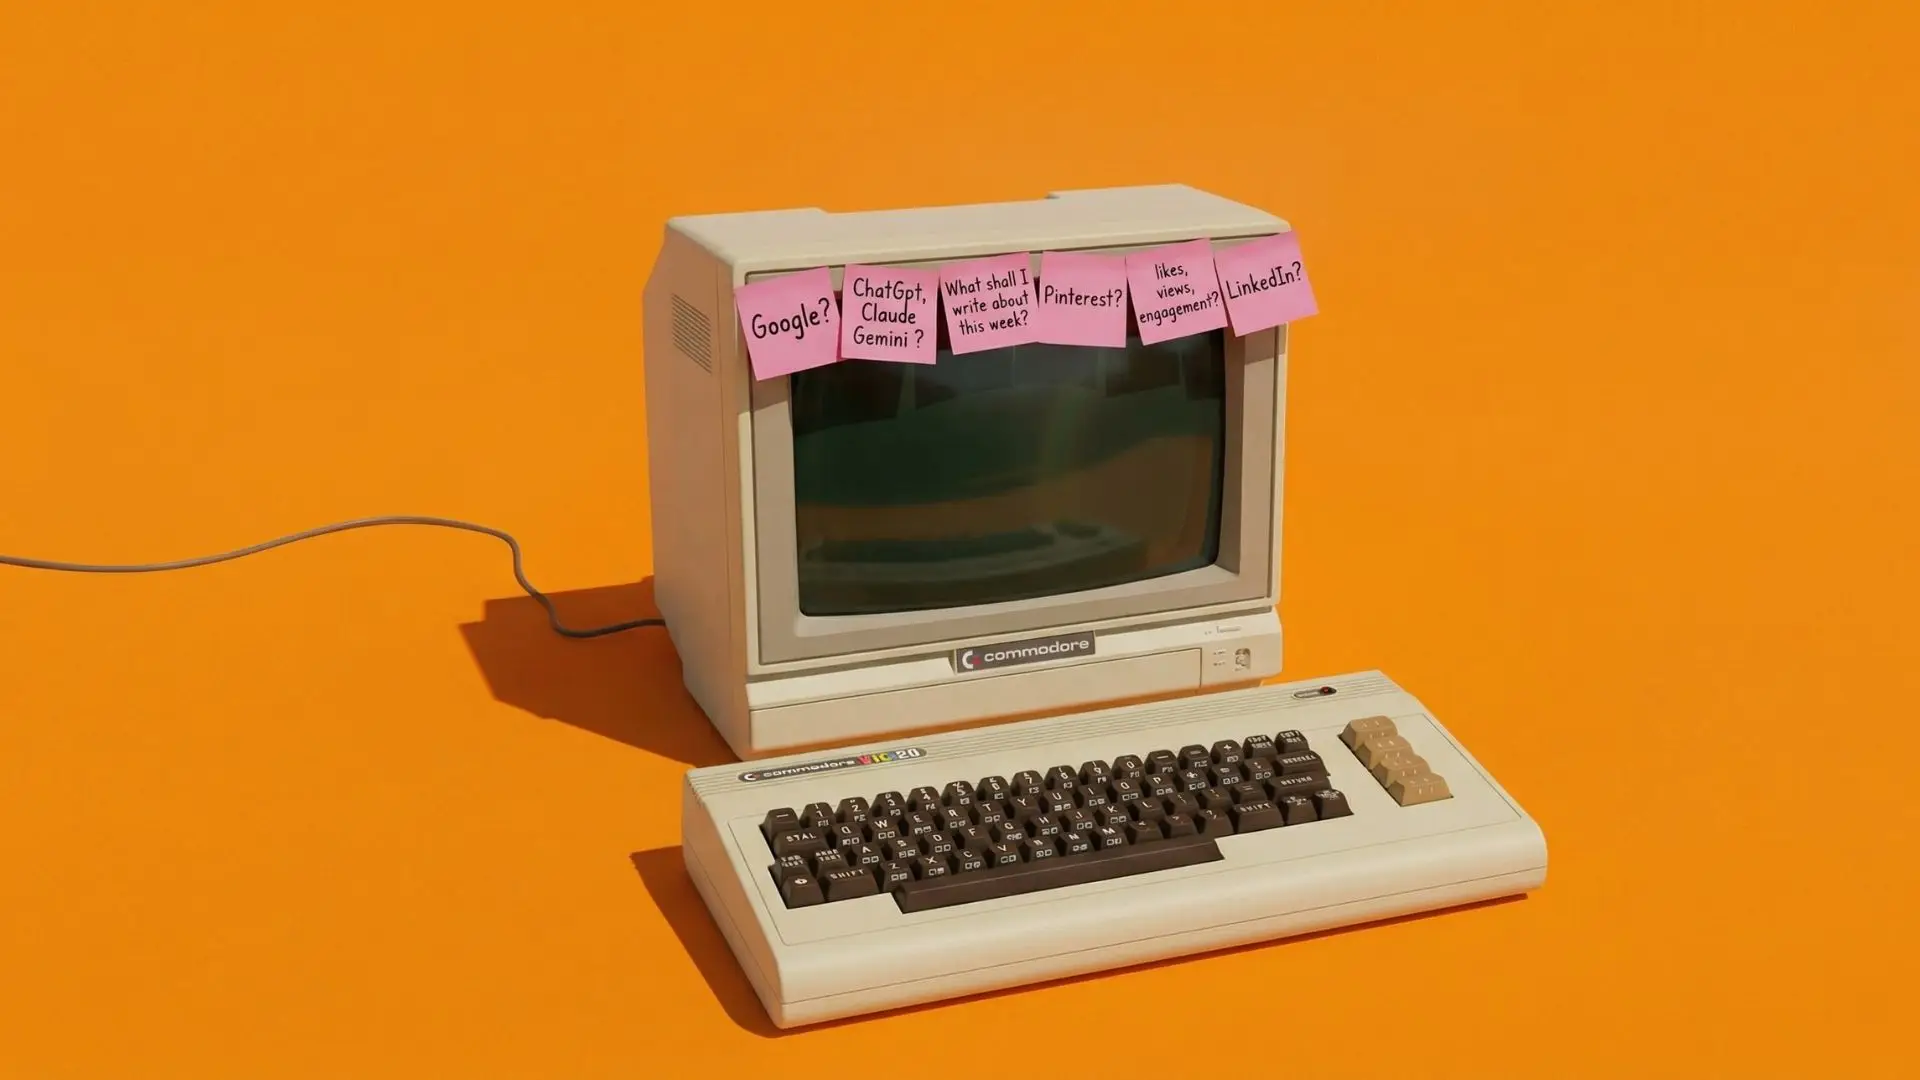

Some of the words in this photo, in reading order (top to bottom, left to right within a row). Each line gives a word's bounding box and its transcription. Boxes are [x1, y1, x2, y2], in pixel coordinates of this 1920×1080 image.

[945, 277, 981, 297] What
[987, 271, 1017, 291] shall
[1020, 268, 1030, 285] I
[1155, 262, 1188, 281] likes,
[1225, 261, 1301, 299] LinkedIn?
[853, 277, 927, 308] ChatGpt,
[1045, 285, 1123, 307] Pinterest?
[1156, 282, 1195, 299] views,
[862, 303, 916, 324] Claude
[952, 299, 987, 316] write
[992, 291, 1029, 309] about
[1139, 291, 1219, 326] engagement?
[752, 297, 830, 339] Google?
[959, 319, 985, 336] this
[990, 309, 1028, 331] week?
[853, 326, 908, 347] Gemini
[915, 329, 924, 348] ?
[983, 638, 1090, 663] commodore
[896, 748, 920, 758] 20
[982, 803, 991, 811] T
[875, 820, 887, 828] W
